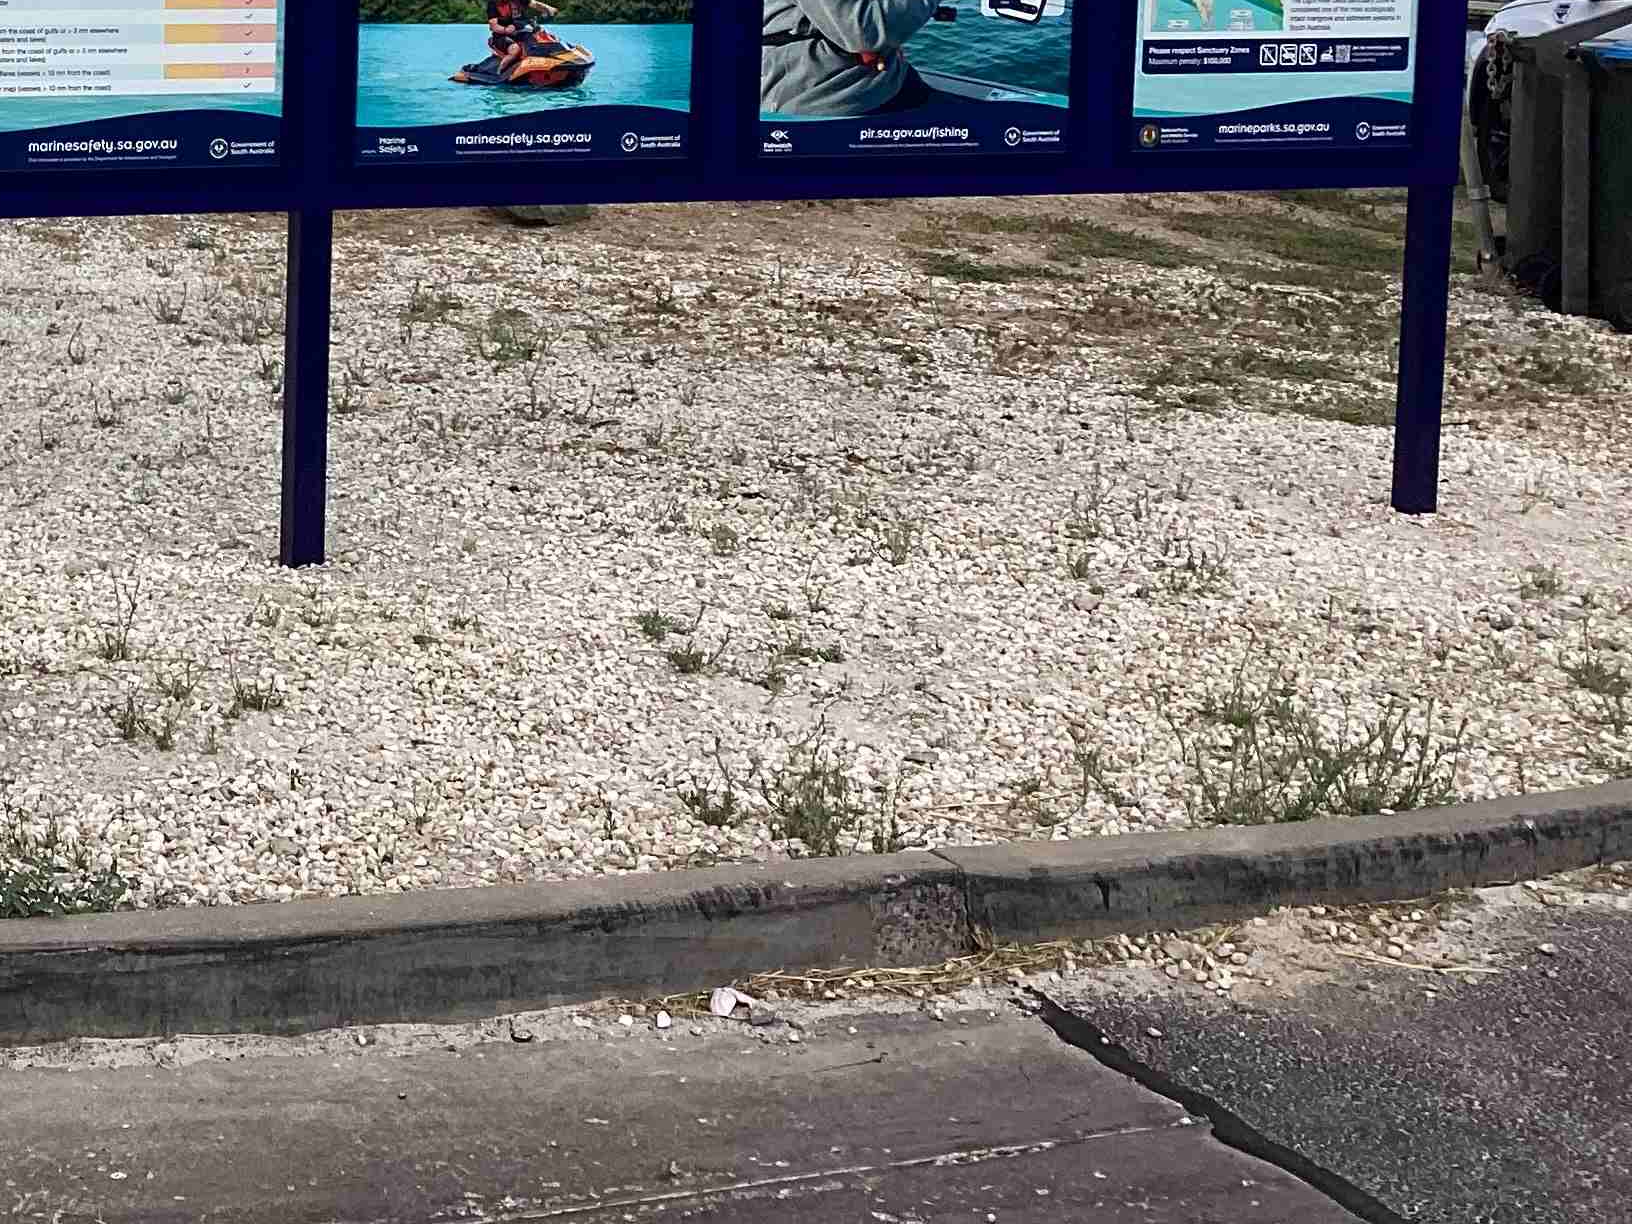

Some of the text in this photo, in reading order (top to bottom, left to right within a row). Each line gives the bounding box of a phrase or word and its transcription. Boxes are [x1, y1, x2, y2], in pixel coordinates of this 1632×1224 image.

[1218, 122, 1329, 134] marineparks.sa.gov.au
[28, 139, 177, 153] marinesafety.sa.gov.au
[455, 132, 591, 146] marinesafety.sa.gov.au
